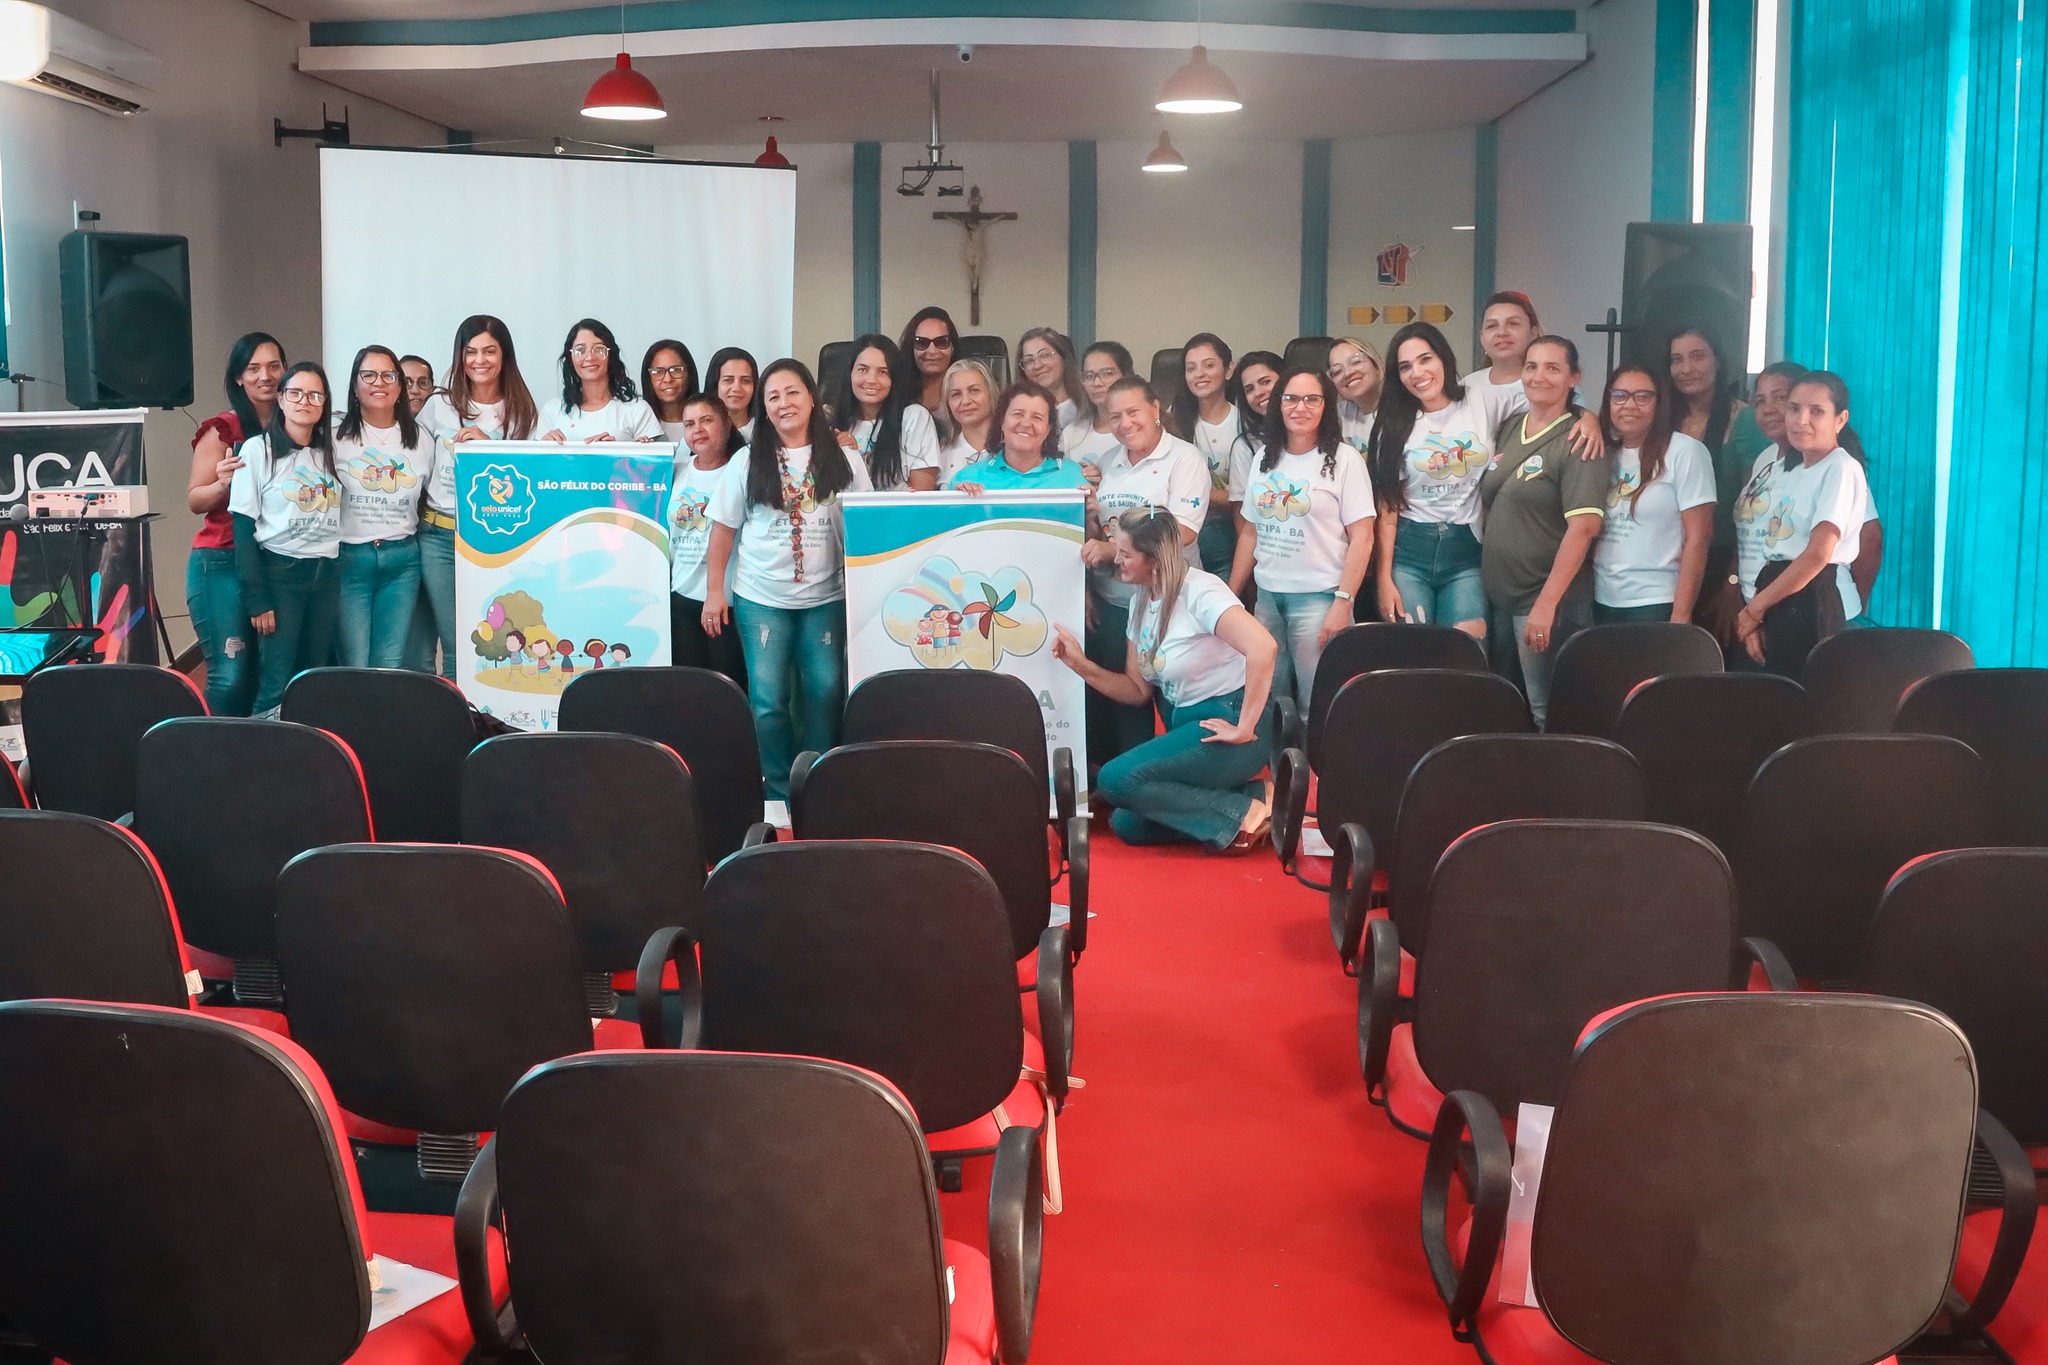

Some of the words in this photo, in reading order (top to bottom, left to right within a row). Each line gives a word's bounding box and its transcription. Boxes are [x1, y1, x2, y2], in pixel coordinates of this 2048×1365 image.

[537, 480, 559, 490] SÃO
[560, 479, 589, 491] FÉLIX
[591, 482, 606, 491] DO
[607, 482, 645, 491] CORIBE
[653, 483, 667, 491] BA
[349, 494, 388, 505] FETIPA
[498, 505, 522, 513] unicef
[1289, 527, 1305, 538] BA
[1056, 720, 1070, 728] do
